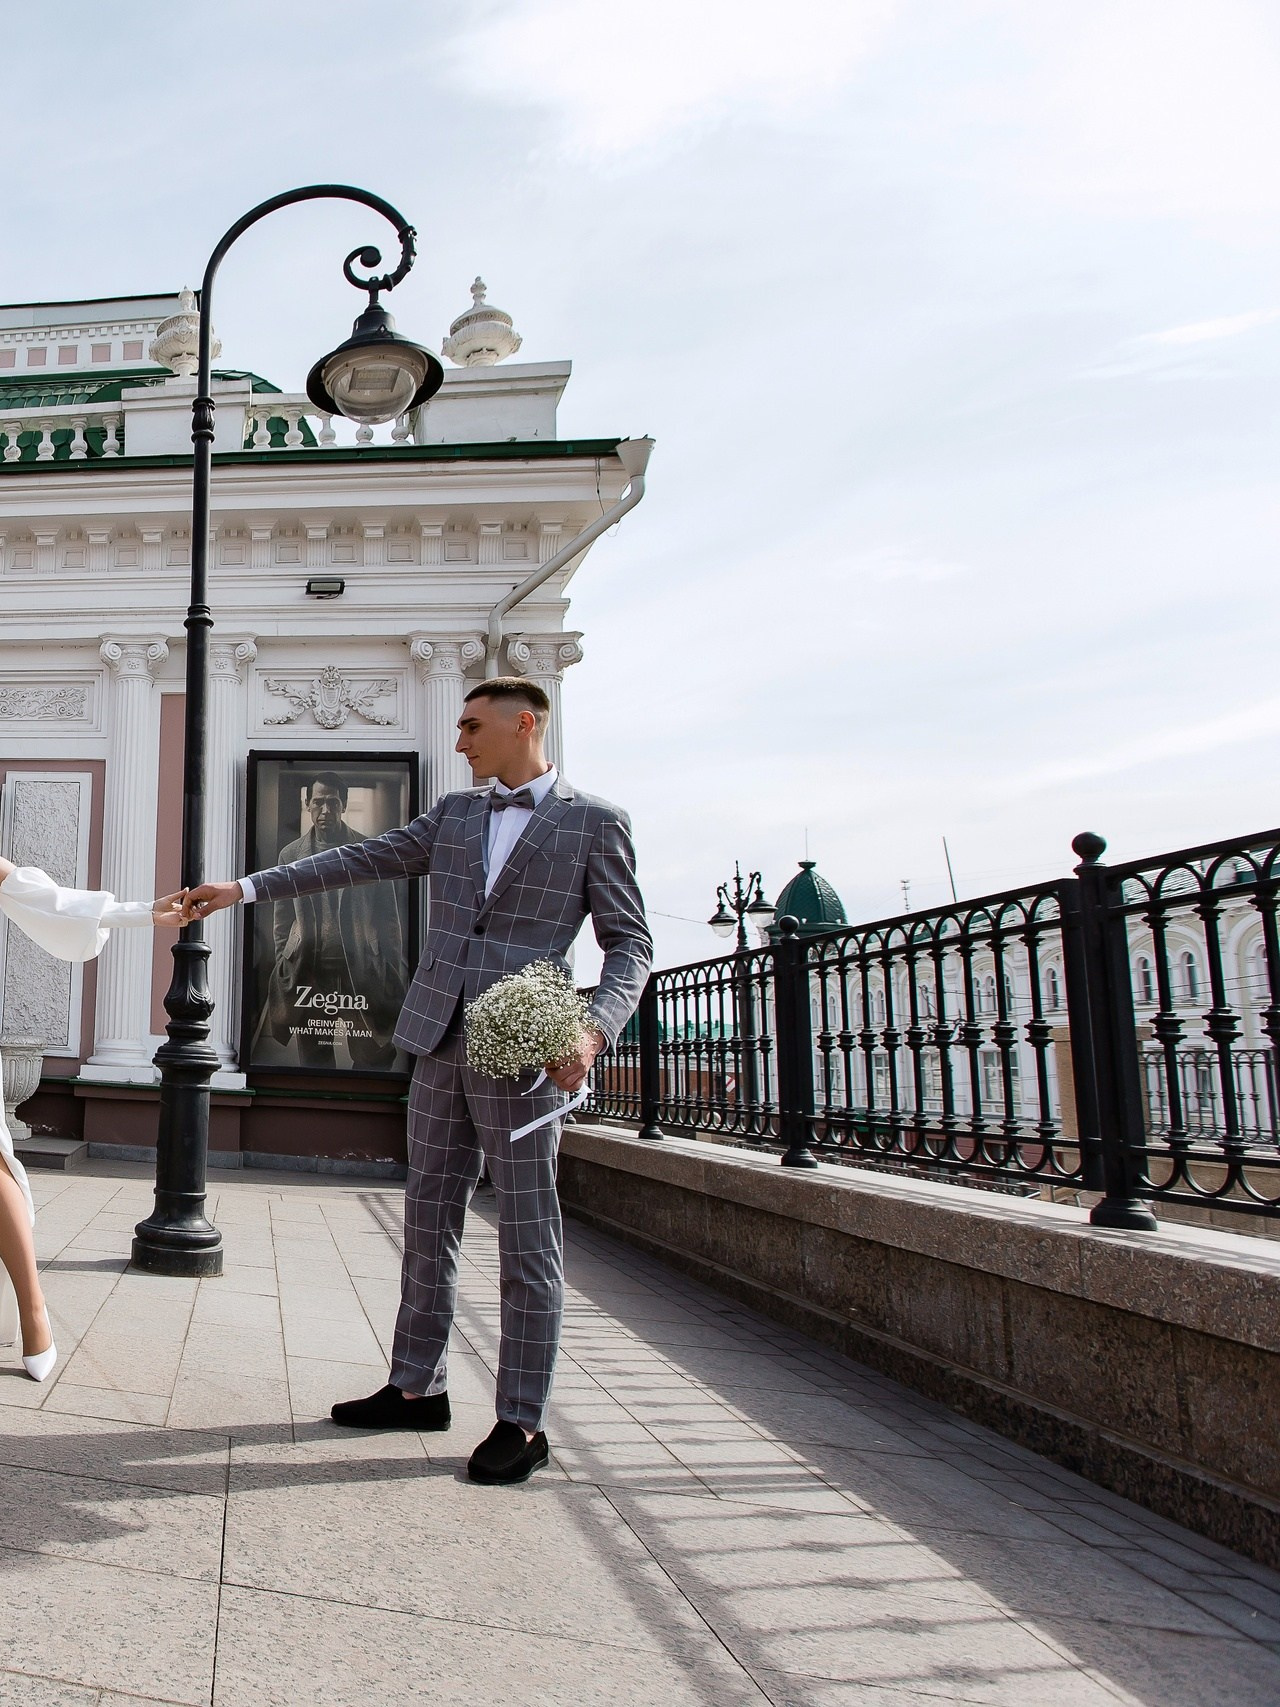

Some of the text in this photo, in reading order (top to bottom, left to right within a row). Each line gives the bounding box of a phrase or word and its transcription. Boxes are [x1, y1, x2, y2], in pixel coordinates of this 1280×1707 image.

[294, 986, 369, 1015] Zegna
[307, 1019, 354, 1029] (REINVENT)
[289, 1027, 314, 1035] WHAT
[314, 1028, 344, 1036] MAKES
[352, 1030, 373, 1038] MAN
